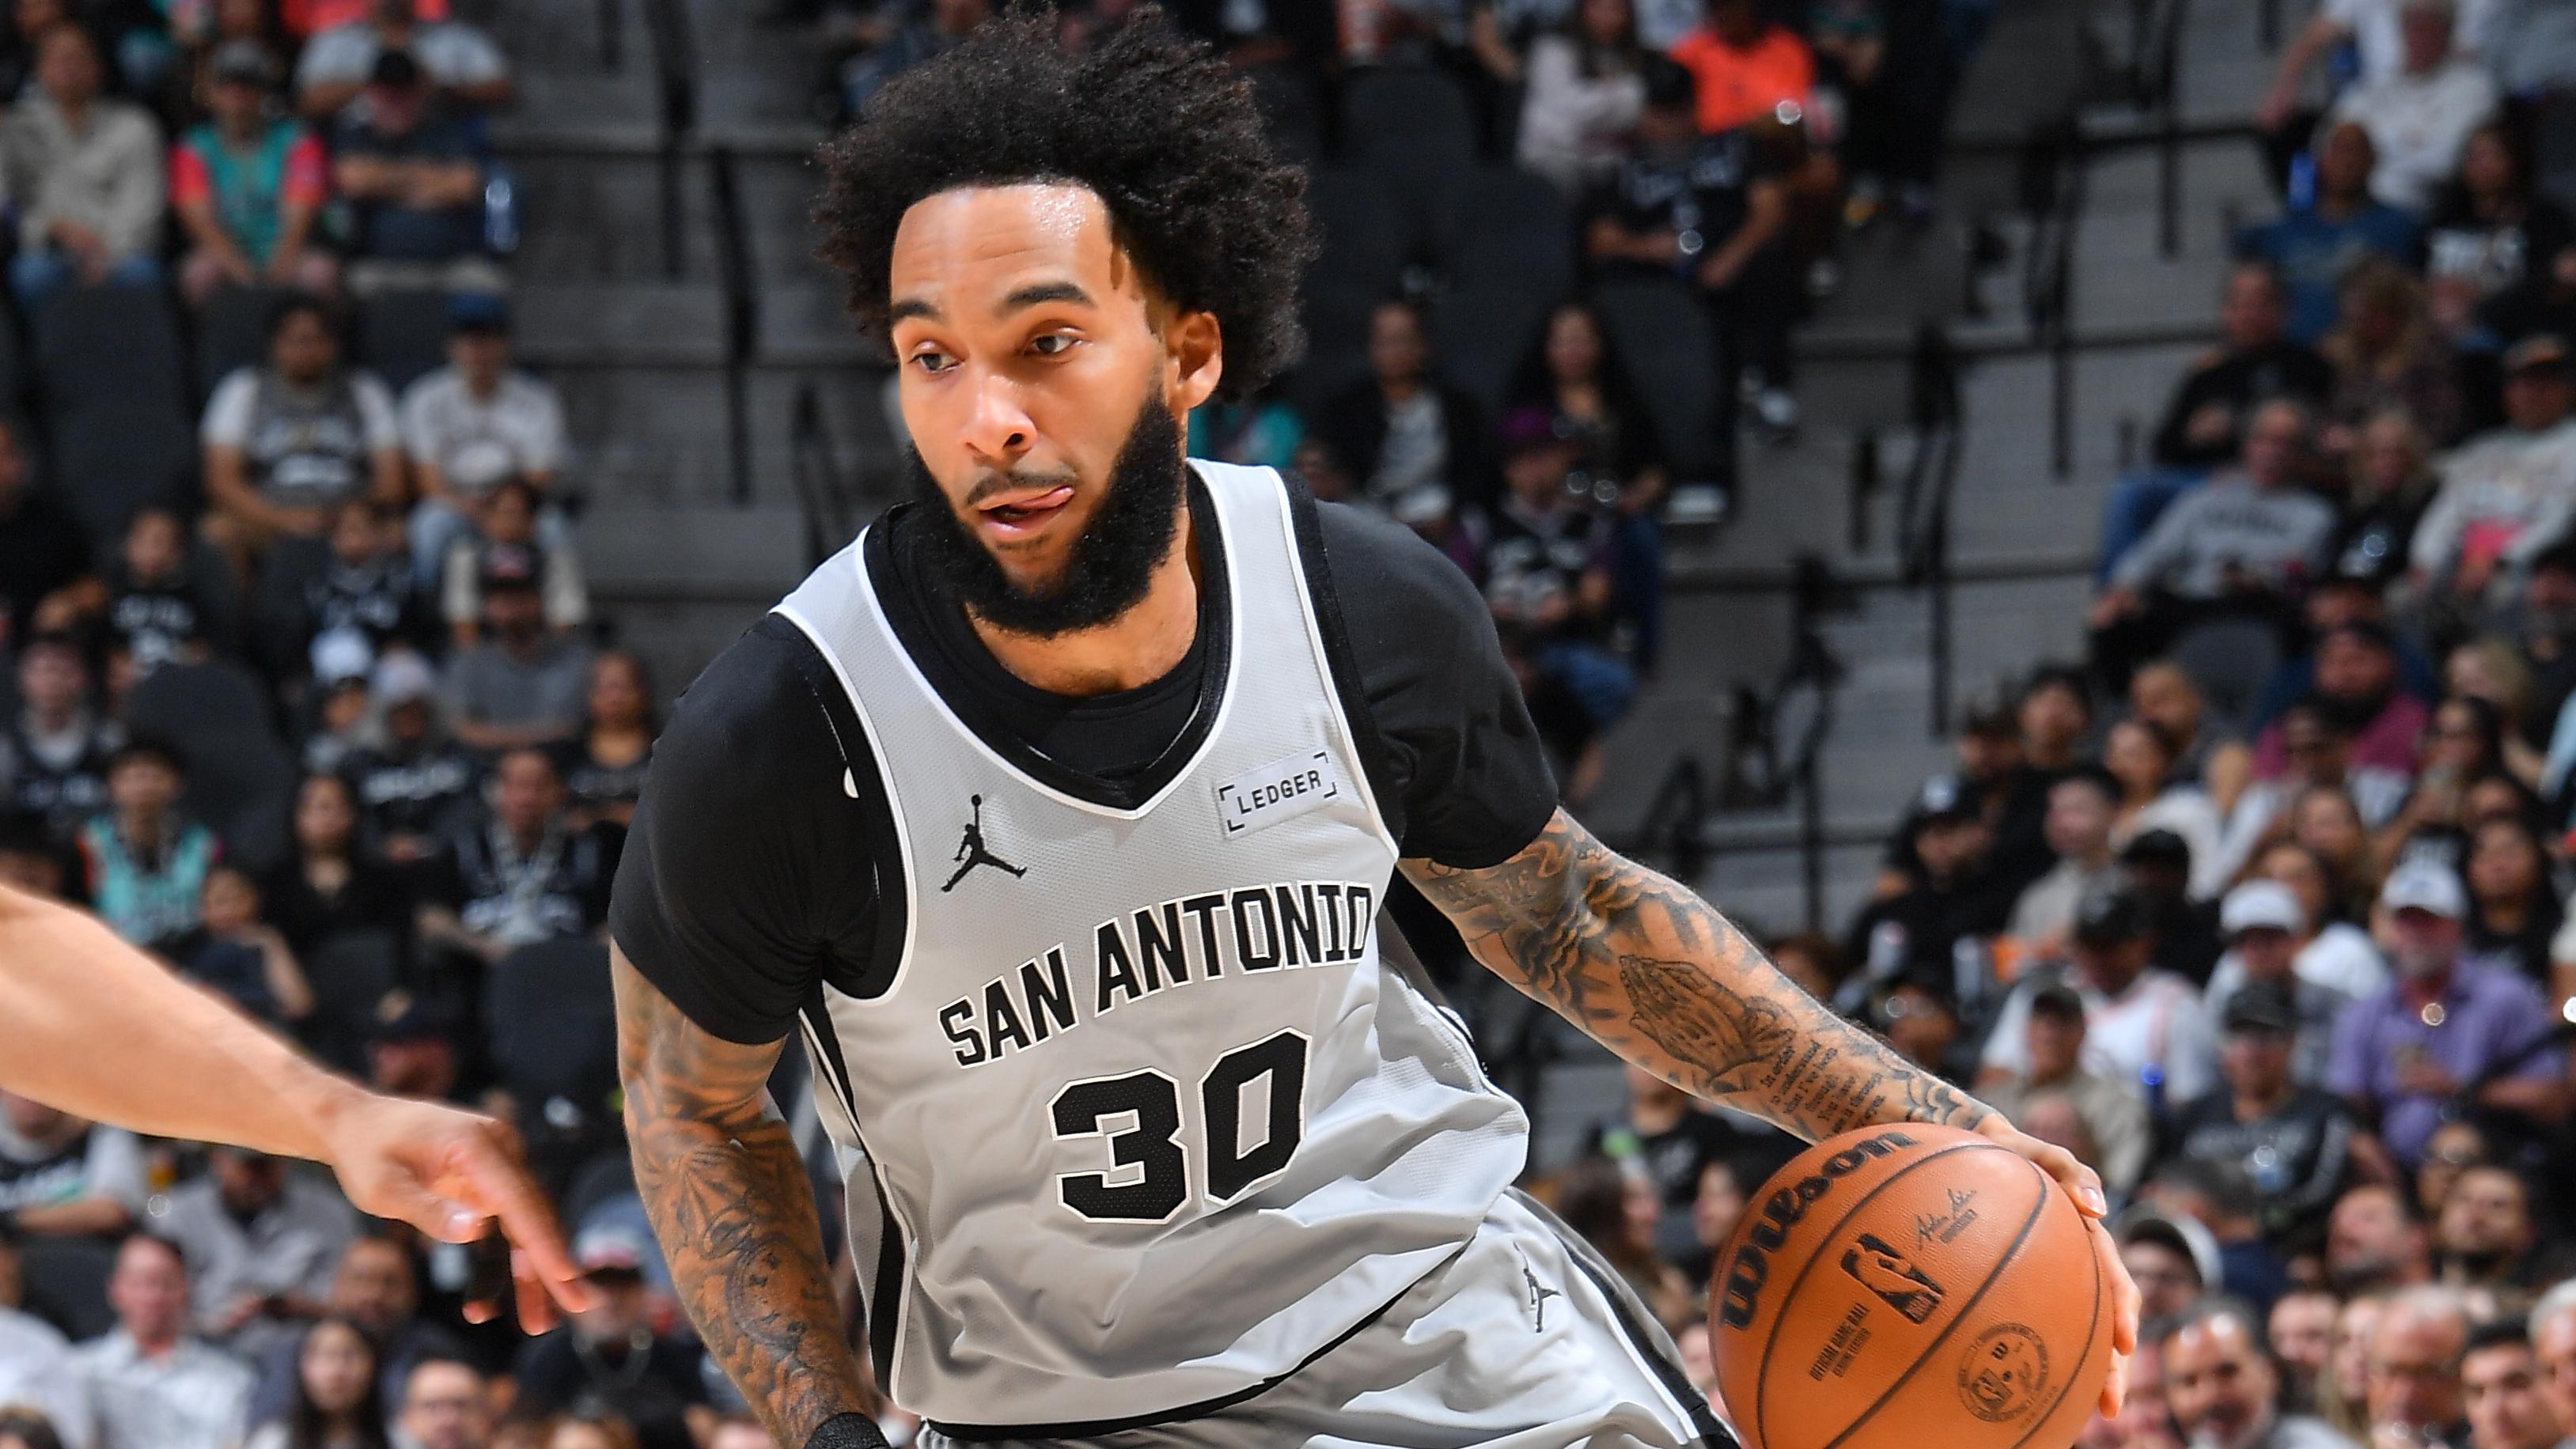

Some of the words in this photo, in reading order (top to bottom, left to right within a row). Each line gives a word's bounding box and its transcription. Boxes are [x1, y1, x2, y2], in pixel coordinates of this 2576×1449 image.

[1237, 770, 1323, 815] LEDGER
[938, 944, 1078, 1069] SAN
[1093, 880, 1373, 1018] ANTONIO
[1047, 1027, 1313, 1225] 30
